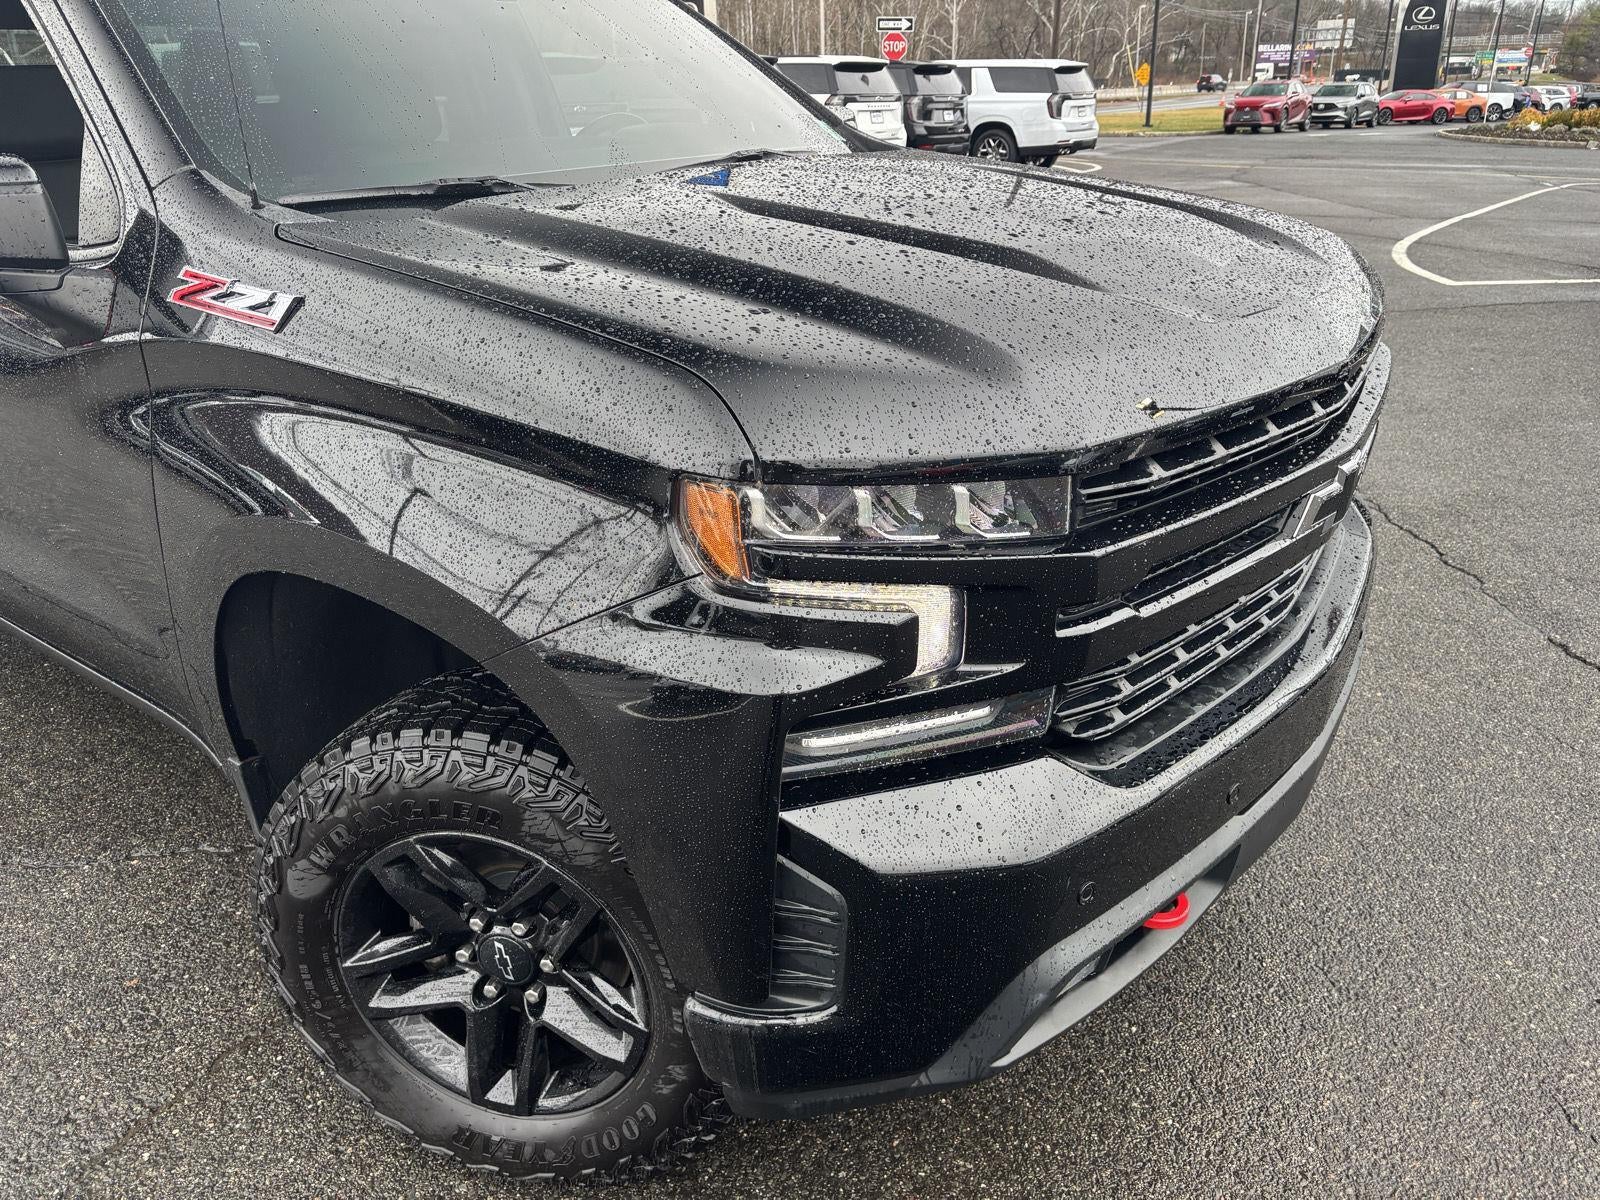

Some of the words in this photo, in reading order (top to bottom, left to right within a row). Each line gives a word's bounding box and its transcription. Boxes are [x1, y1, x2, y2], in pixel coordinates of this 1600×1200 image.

[883, 40, 906, 52] STOP
[1404, 23, 1440, 31] LEXUS
[167, 265, 306, 335] Z71
[307, 798, 503, 873] WRANGLER
[451, 1101, 658, 1168] GOODYEAR
